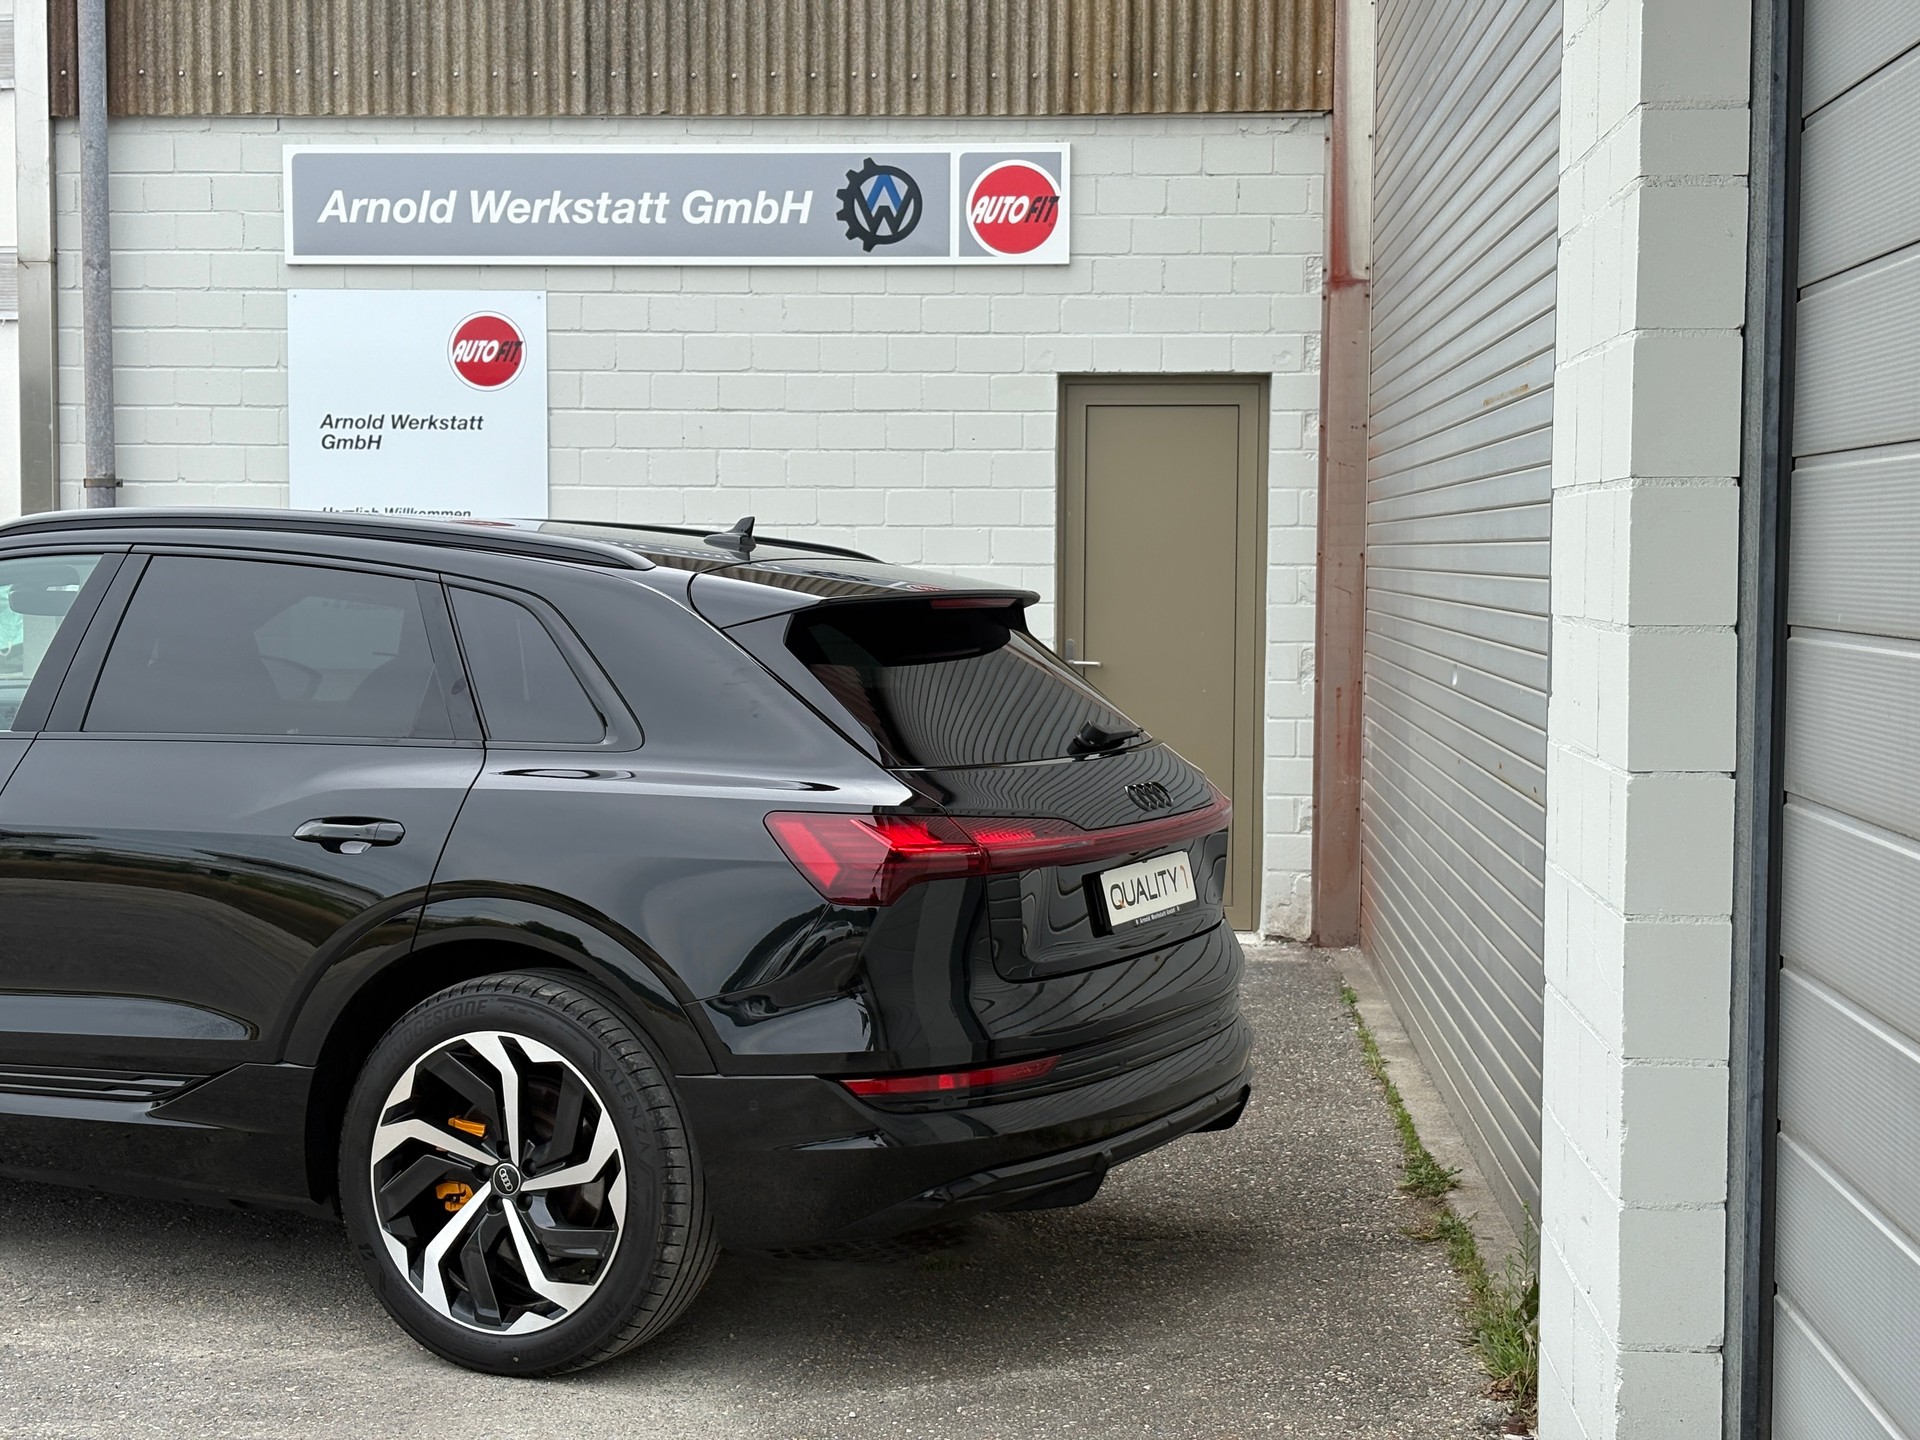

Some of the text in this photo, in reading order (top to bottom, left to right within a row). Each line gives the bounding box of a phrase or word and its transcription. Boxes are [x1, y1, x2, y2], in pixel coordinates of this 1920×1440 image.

[317, 190, 813, 224] Arnold Werkstatt GmbH
[971, 195, 1060, 224] AUTOFIT
[453, 339, 523, 363] AUTOFIT
[320, 413, 484, 431] Arnold Werkstatt
[321, 434, 382, 450] GmbH
[1110, 867, 1177, 910] QUALITY
